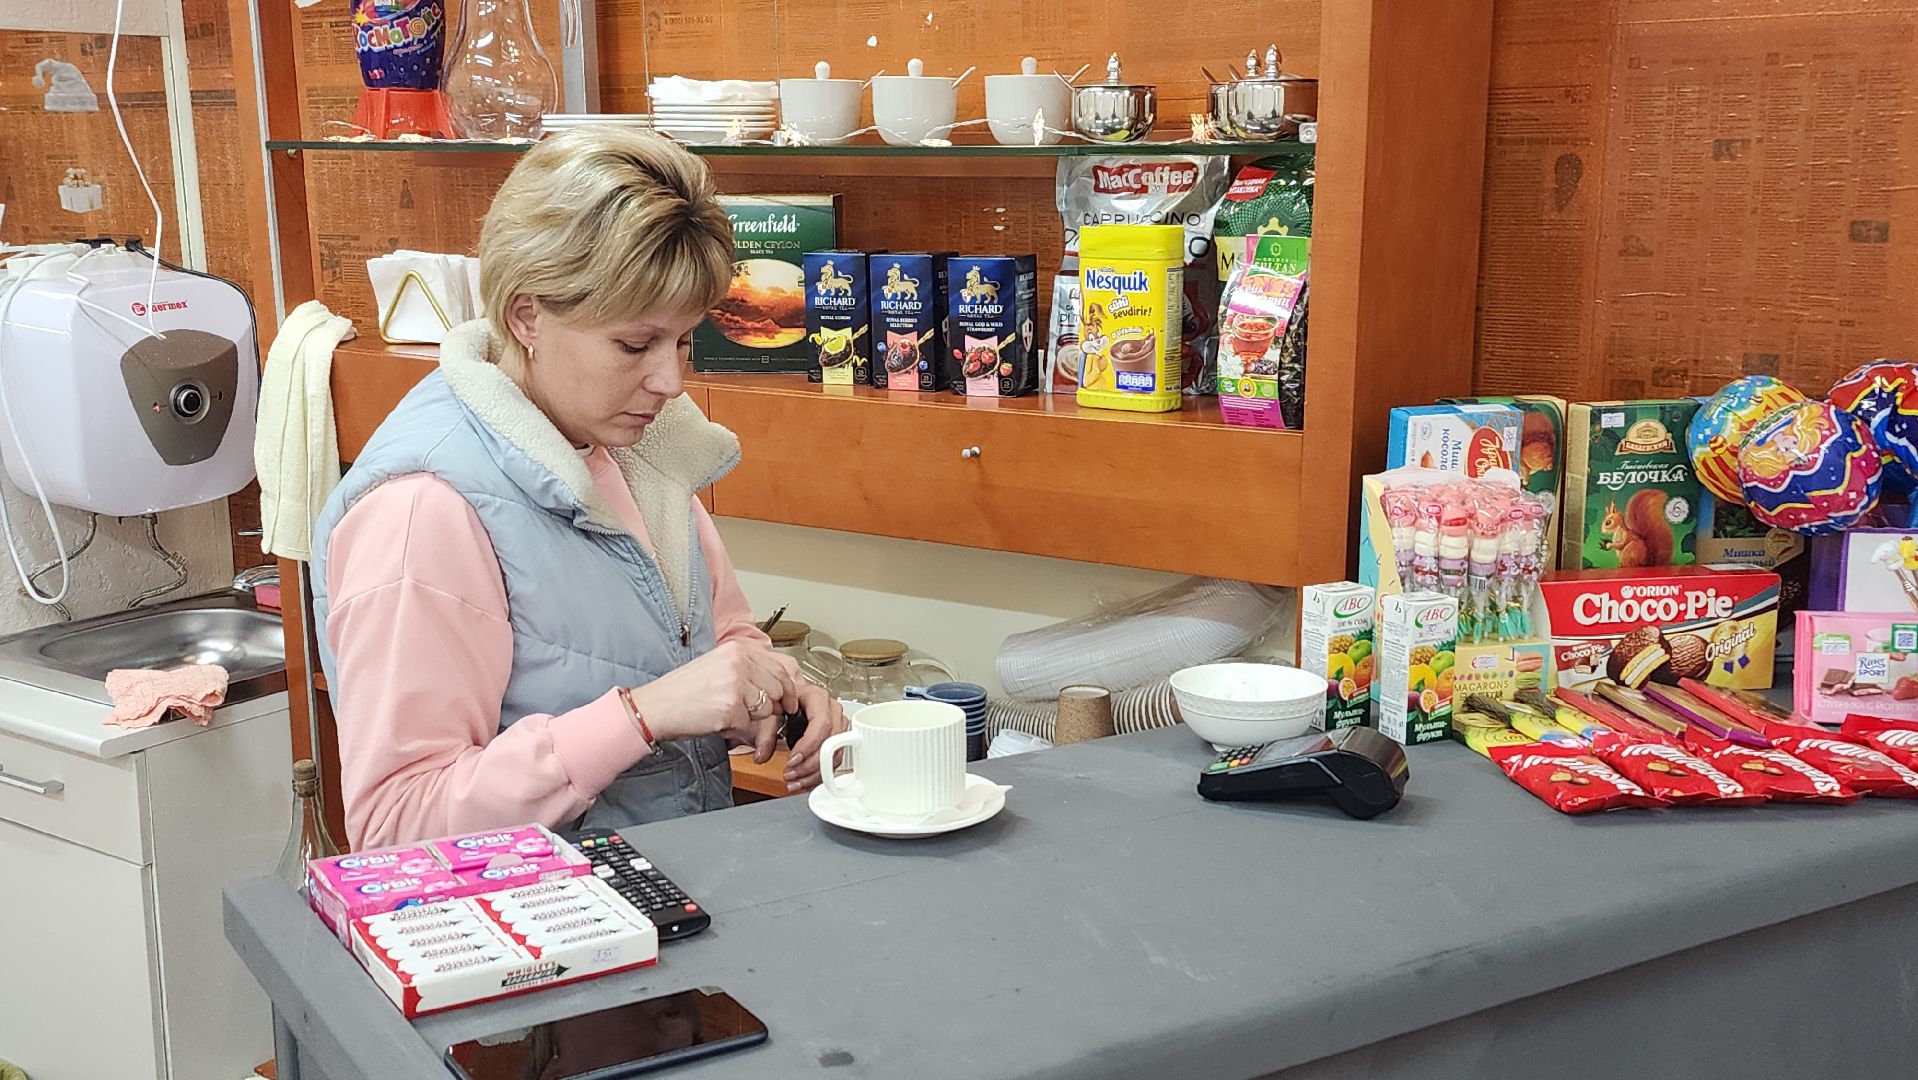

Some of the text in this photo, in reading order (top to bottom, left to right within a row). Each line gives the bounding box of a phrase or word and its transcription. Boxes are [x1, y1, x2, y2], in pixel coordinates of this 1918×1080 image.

[1097, 166, 1195, 190] MacCoffee
[733, 240, 800, 249] OLDEN CEYLON
[1255, 262, 1298, 273] SULTAN
[1086, 269, 1149, 295] Nesquik
[815, 297, 856, 306] RICHARD
[881, 301, 922, 310] RICHARD
[958, 305, 1003, 314] RICHARD
[1113, 306, 1152, 320] sevdirir!
[1439, 428, 1450, 471] косола
[1451, 440, 1462, 469] Миш
[1597, 464, 1687, 491] БЕЛОЧКА
[1672, 501, 1681, 517] 6
[1343, 596, 1367, 611] ABC
[1422, 606, 1450, 621] ABC
[1705, 622, 1756, 662] Original
[453, 833, 515, 849] Orbit
[336, 854, 399, 869] Orbit
[479, 863, 540, 880] Orbit
[357, 878, 422, 894] Orbit
